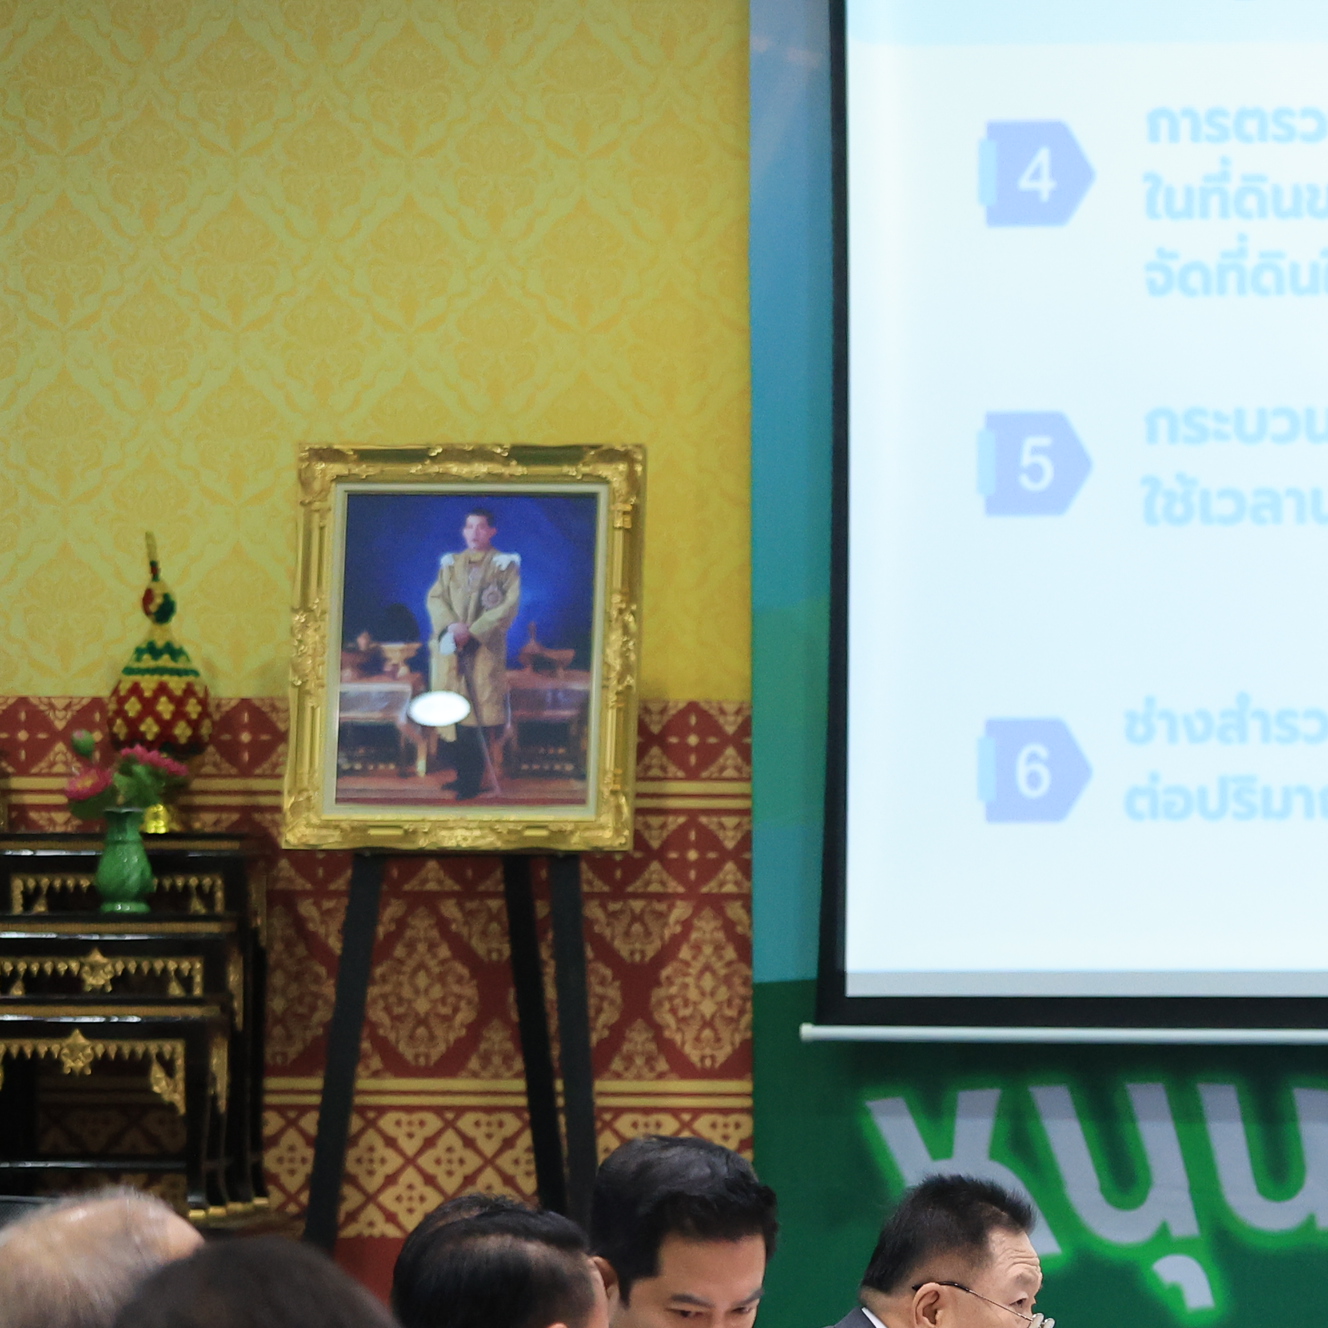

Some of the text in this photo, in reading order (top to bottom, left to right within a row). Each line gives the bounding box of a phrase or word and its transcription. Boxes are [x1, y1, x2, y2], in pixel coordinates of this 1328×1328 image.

[1018, 146, 1058, 203] 4
[1019, 436, 1054, 491] 5
[1016, 743, 1051, 799] 6
